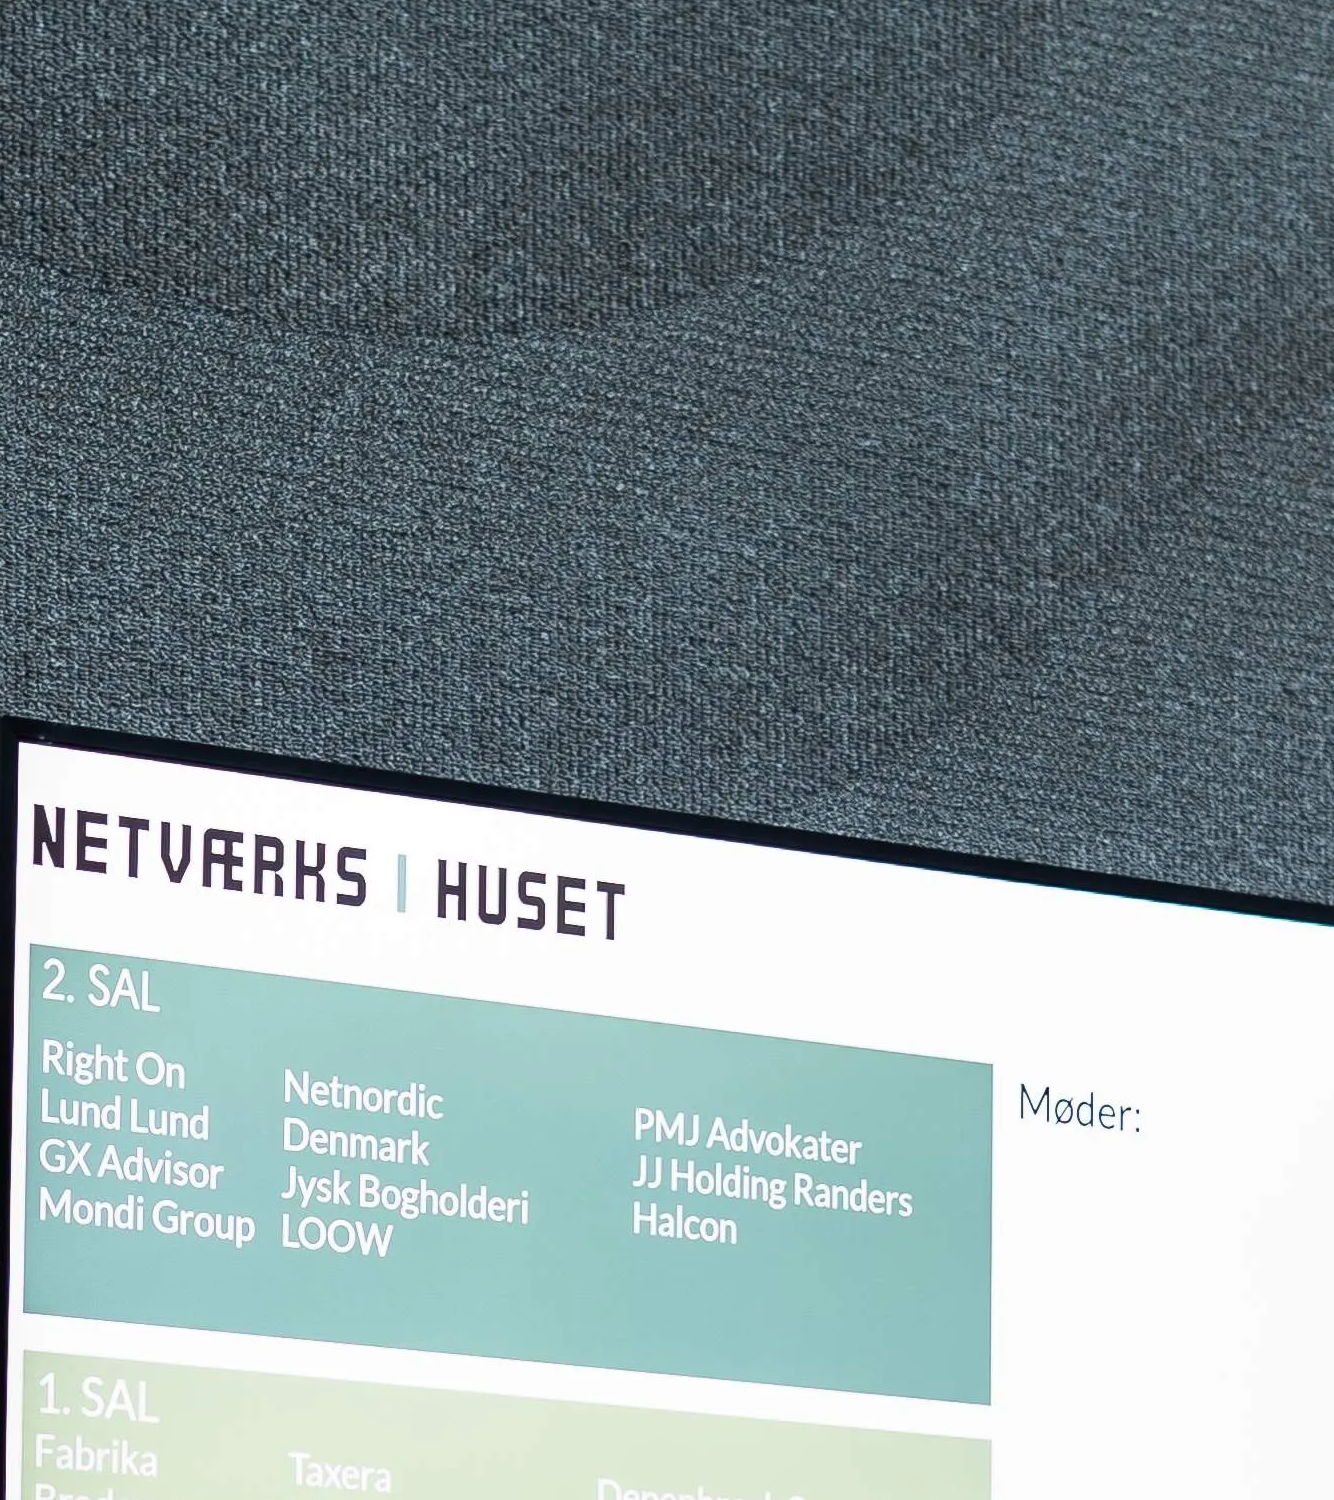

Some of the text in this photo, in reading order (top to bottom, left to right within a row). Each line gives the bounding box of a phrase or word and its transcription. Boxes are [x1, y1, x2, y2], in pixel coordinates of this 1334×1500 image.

[32, 804, 626, 940] NETVÆRKS HUSET
[42, 958, 161, 1013] 2. SAL
[41, 1039, 186, 1090] Right On
[41, 1088, 210, 1141] Lund Lund
[284, 1069, 443, 1121] Netnordic
[1020, 1083, 1142, 1133] Møder:
[284, 1118, 430, 1168] Denmark
[634, 1107, 862, 1167] PMJ Advokater
[39, 1139, 224, 1192] GX Advisor
[632, 1156, 913, 1219] JJ Holding Randers
[39, 1188, 255, 1250] Mondi Group
[280, 1166, 529, 1226] Jysk Bogholderi
[282, 1215, 394, 1259] LOOW
[633, 1203, 738, 1247] Halcon
[38, 1373, 159, 1426] 1. SAL
[35, 1434, 159, 1479] Fabrika
[287, 1450, 392, 1495] Taxera
